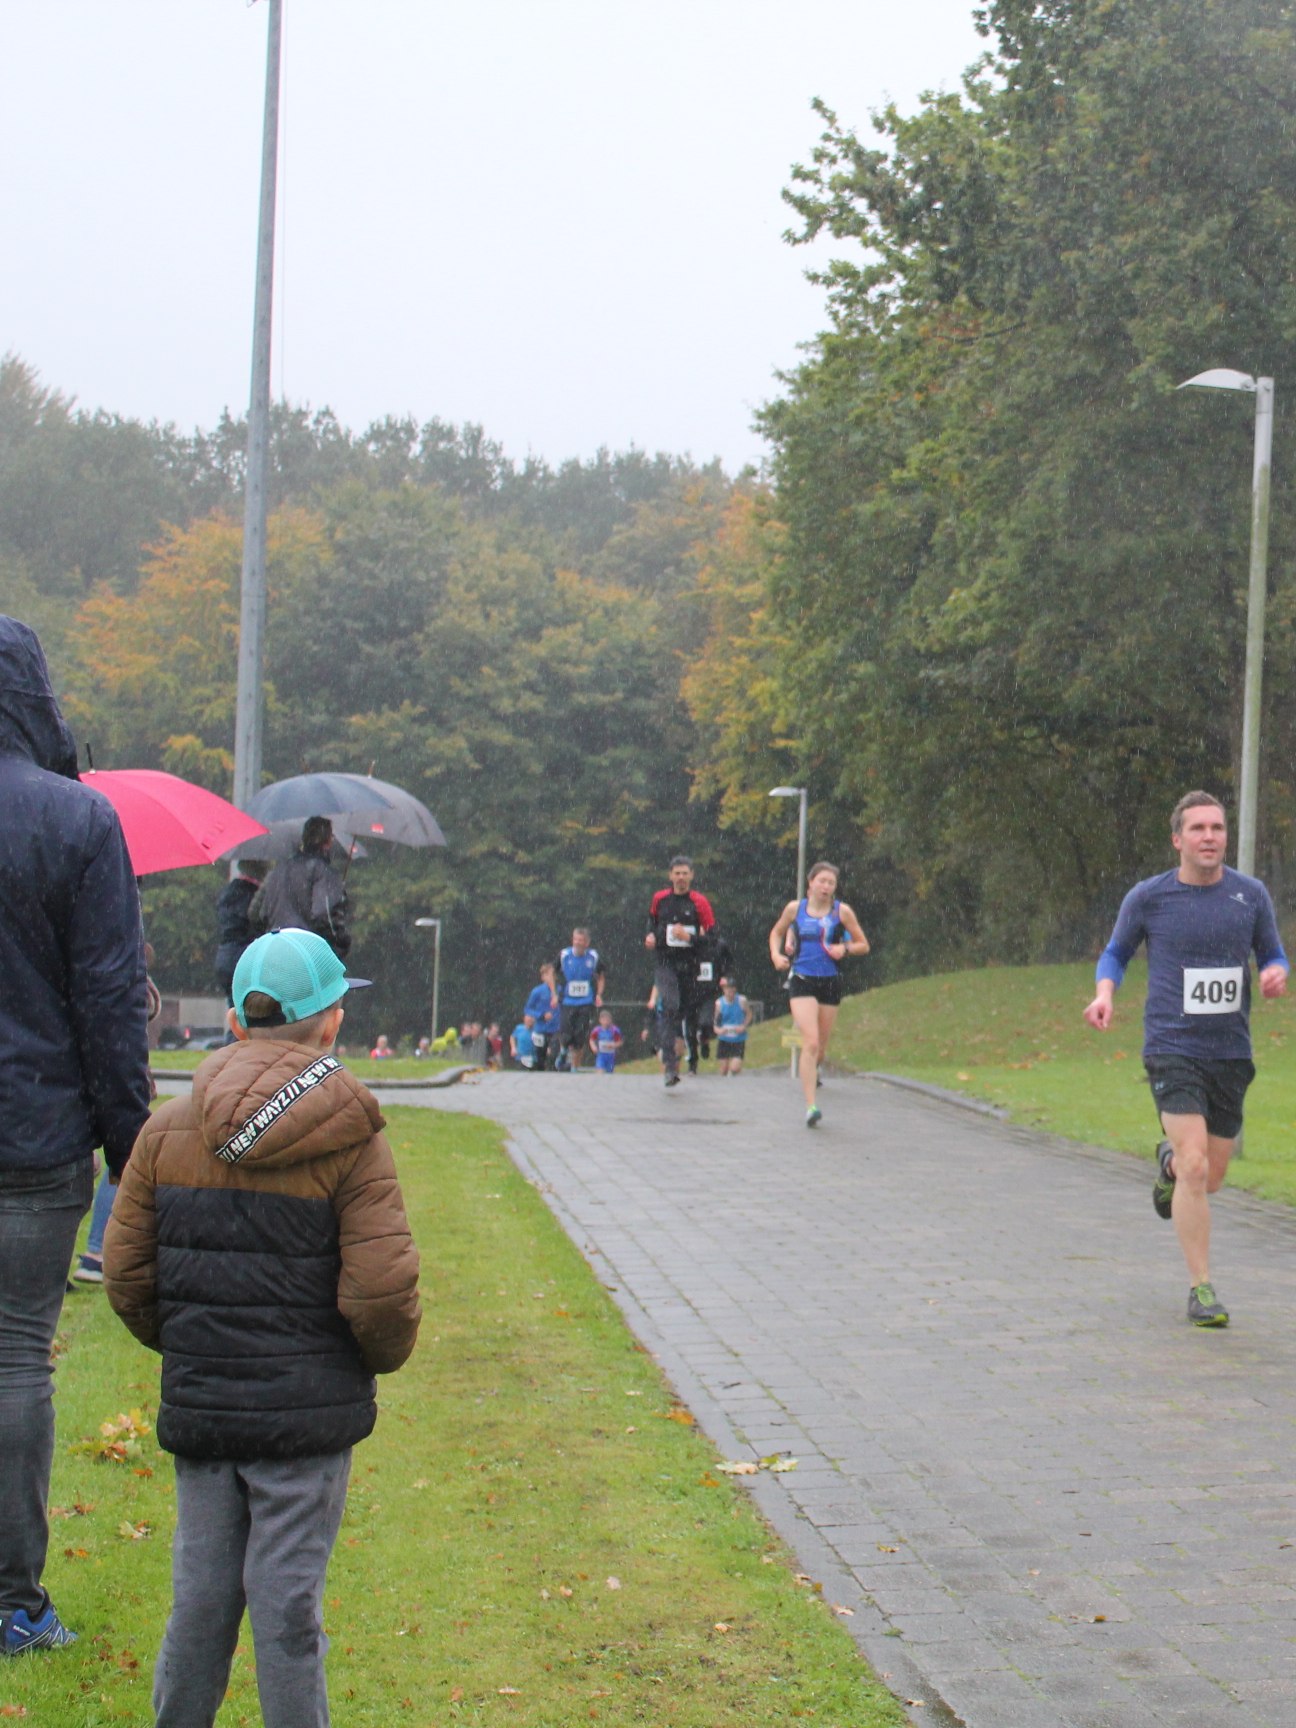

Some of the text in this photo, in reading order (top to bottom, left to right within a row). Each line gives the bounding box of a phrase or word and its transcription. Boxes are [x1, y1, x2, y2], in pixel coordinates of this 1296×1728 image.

[1191, 981, 1237, 1003] 409
[230, 1122, 256, 1155] NEW
[254, 1091, 291, 1129] WAYZ
[297, 1062, 327, 1088] NEW
